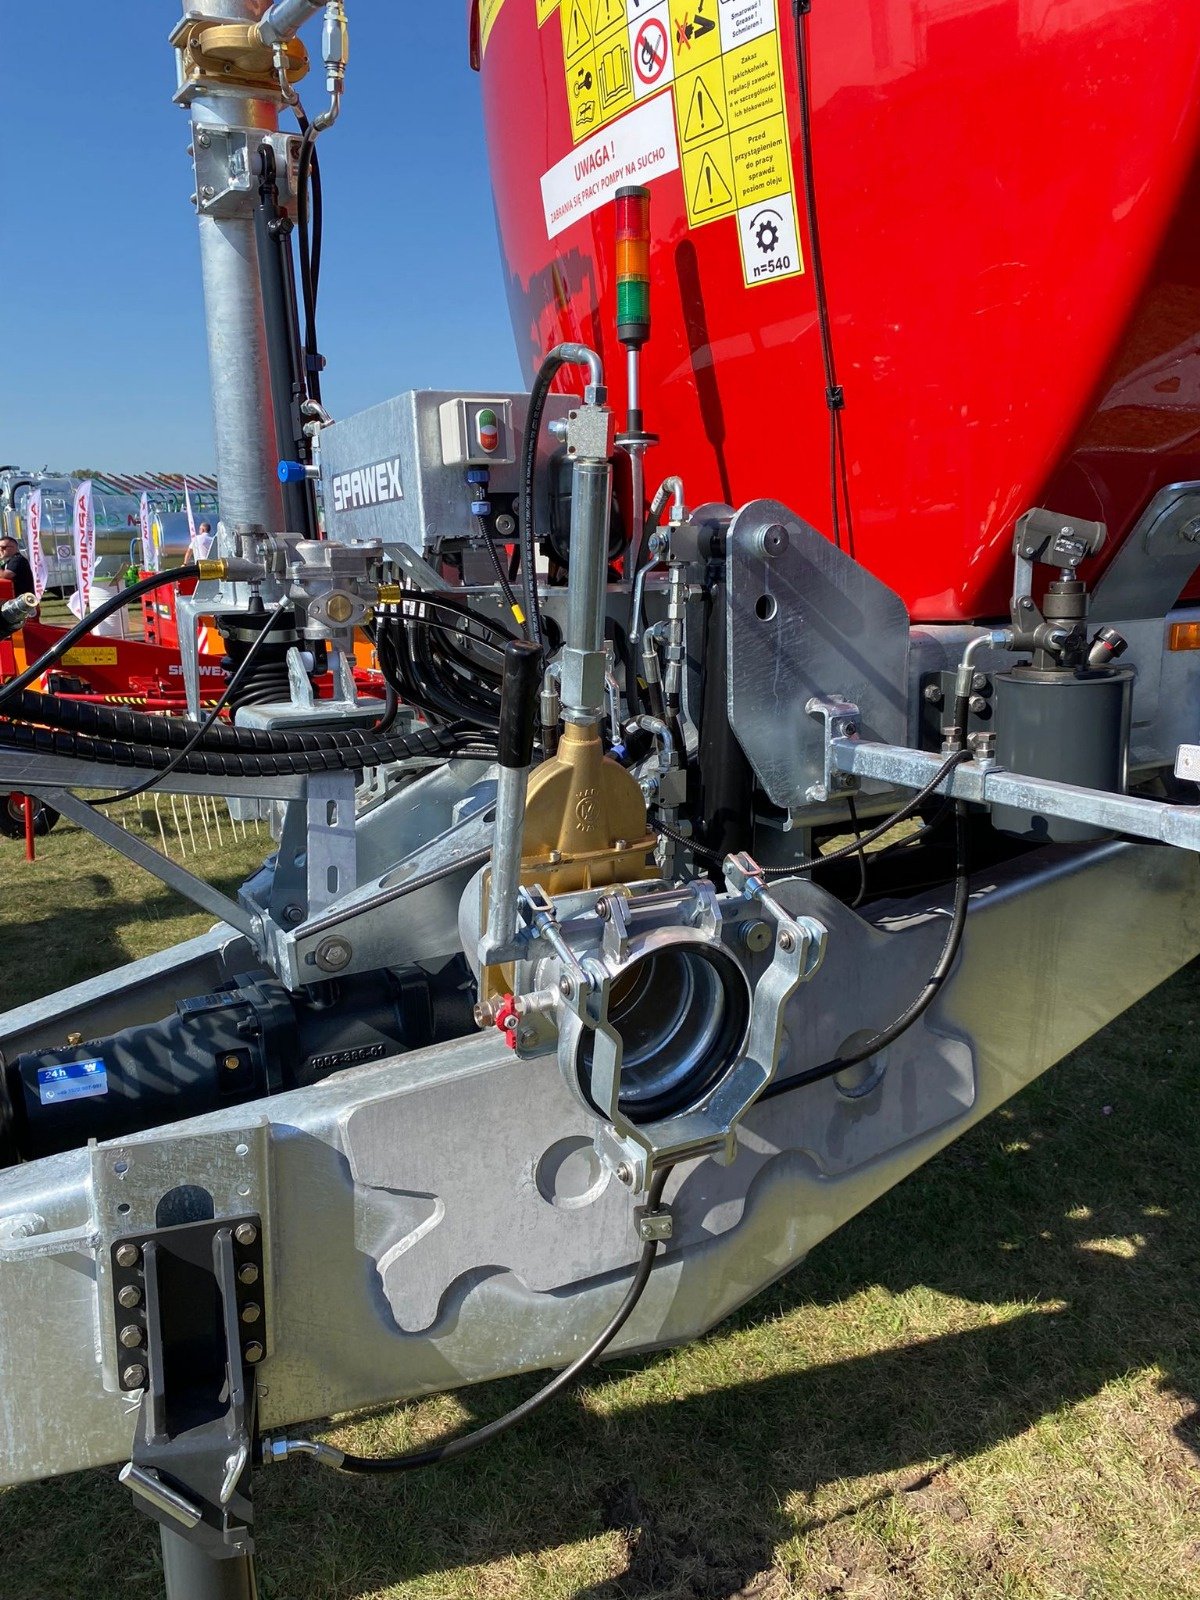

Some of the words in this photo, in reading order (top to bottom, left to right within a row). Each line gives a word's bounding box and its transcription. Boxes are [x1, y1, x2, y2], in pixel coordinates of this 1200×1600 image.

[732, 20, 760, 37] Schmieren
[735, 14, 754, 27] Grease
[741, 53, 757, 64] Zakaz
[732, 60, 769, 83] jakichkolwiek
[728, 81, 751, 96] regulacji
[751, 71, 776, 85] zaworów
[740, 82, 777, 104] szczególności
[734, 109, 742, 118] ich
[743, 97, 773, 114] blokowania
[747, 131, 766, 144] Przed
[734, 138, 783, 162] przystąpieniem
[574, 145, 610, 182] UWAGA
[610, 140, 616, 159] !
[745, 160, 754, 170] do
[755, 154, 774, 167] pracy
[748, 166, 775, 181] sprawdź
[550, 200, 574, 224] ZABRANIA
[581, 182, 600, 202] PRACY
[600, 167, 624, 190] POMPY
[625, 162, 637, 176] NA
[637, 147, 666, 170] SUCHO
[742, 182, 765, 197] poziom
[765, 177, 783, 188] oleju
[753, 255, 791, 278] n=540
[333, 458, 403, 511] SPAWEX
